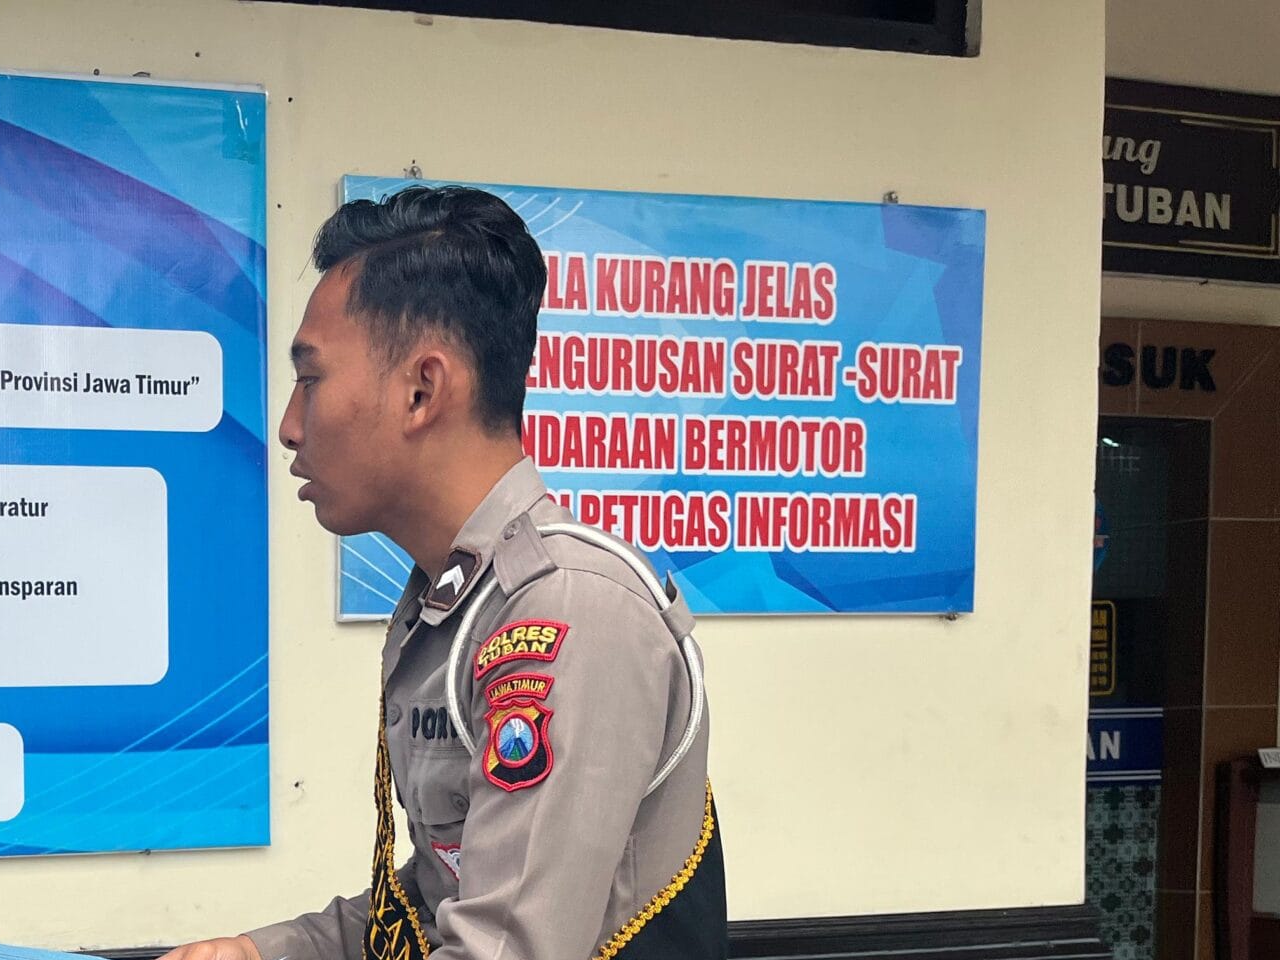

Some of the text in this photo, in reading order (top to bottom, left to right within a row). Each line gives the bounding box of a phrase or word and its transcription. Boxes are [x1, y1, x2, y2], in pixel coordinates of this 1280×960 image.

[596, 257, 734, 317] KURANG
[742, 264, 834, 320] JELAS
[0, 370, 78, 393] Provinsi
[83, 372, 131, 395] Jawa
[733, 341, 839, 397] SURAT
[684, 417, 864, 474] BERMOTOR
[737, 494, 915, 549] INFORMASI
[479, 626, 558, 657] POLRES
[479, 641, 547, 667] TUBAN
[490, 679, 546, 698] JAWA TIMUR
